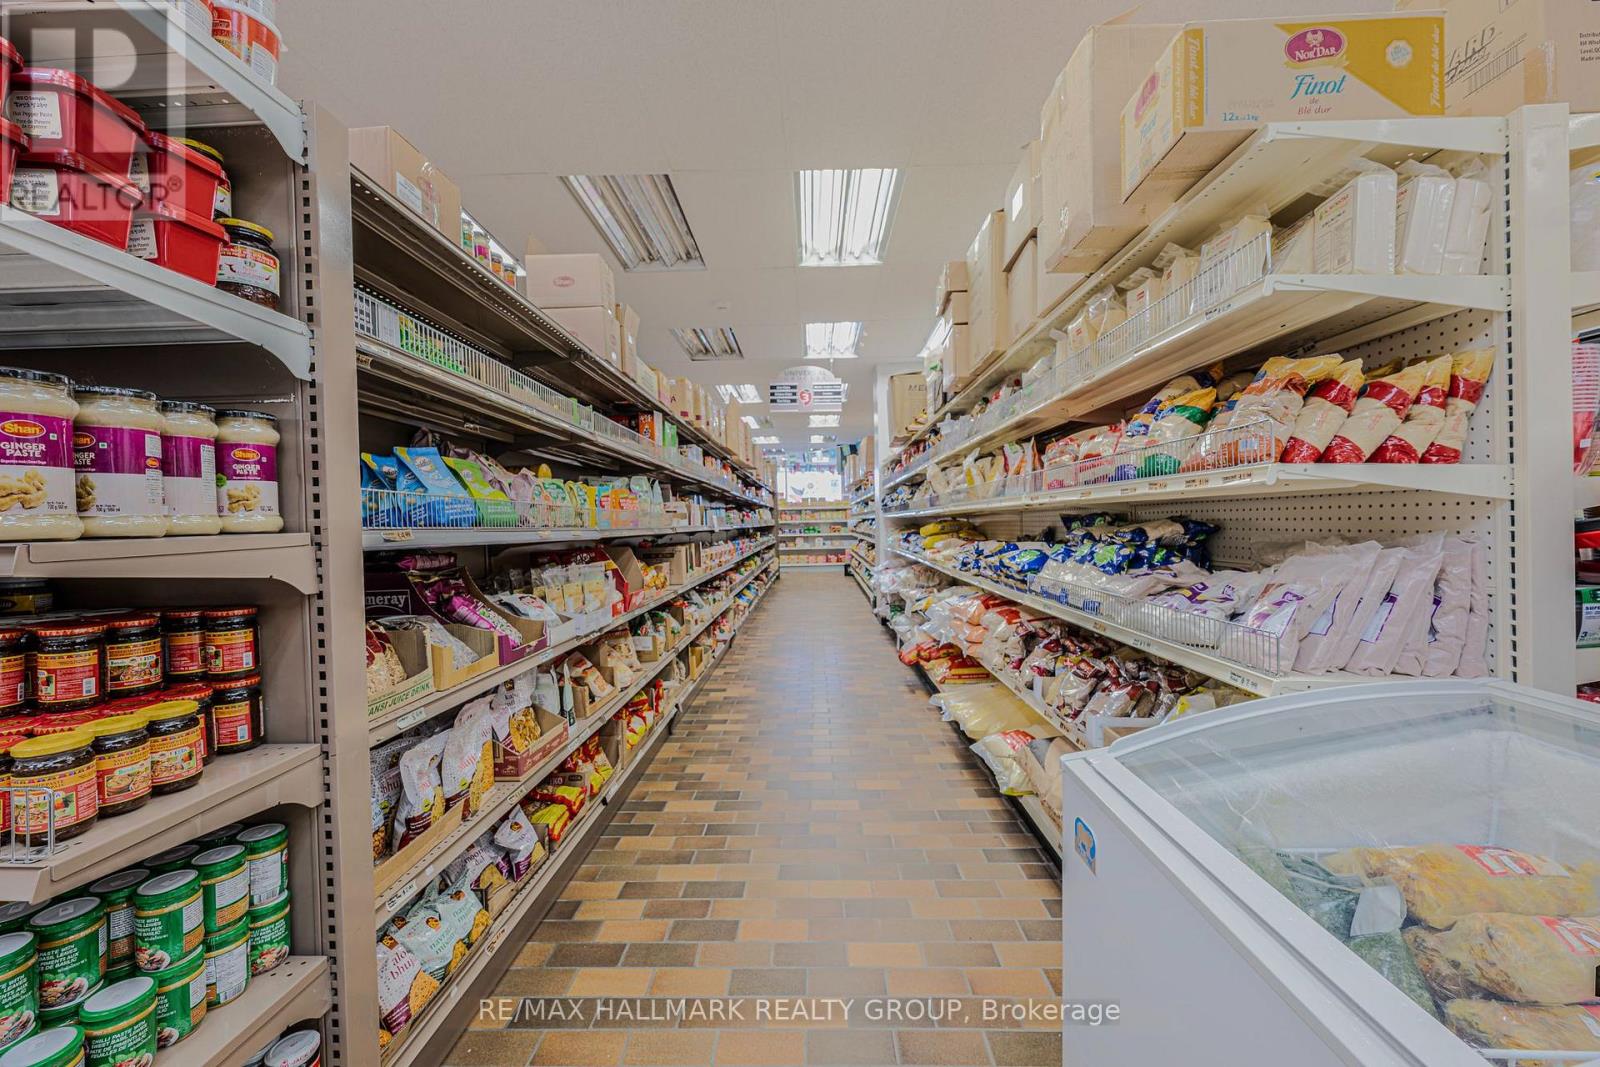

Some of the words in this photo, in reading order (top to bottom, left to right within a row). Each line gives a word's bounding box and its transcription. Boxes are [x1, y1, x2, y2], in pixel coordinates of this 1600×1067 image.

[4, 423, 41, 435] Shan
[1, 442, 46, 451] GINGER
[6, 449, 41, 458] PASTE
